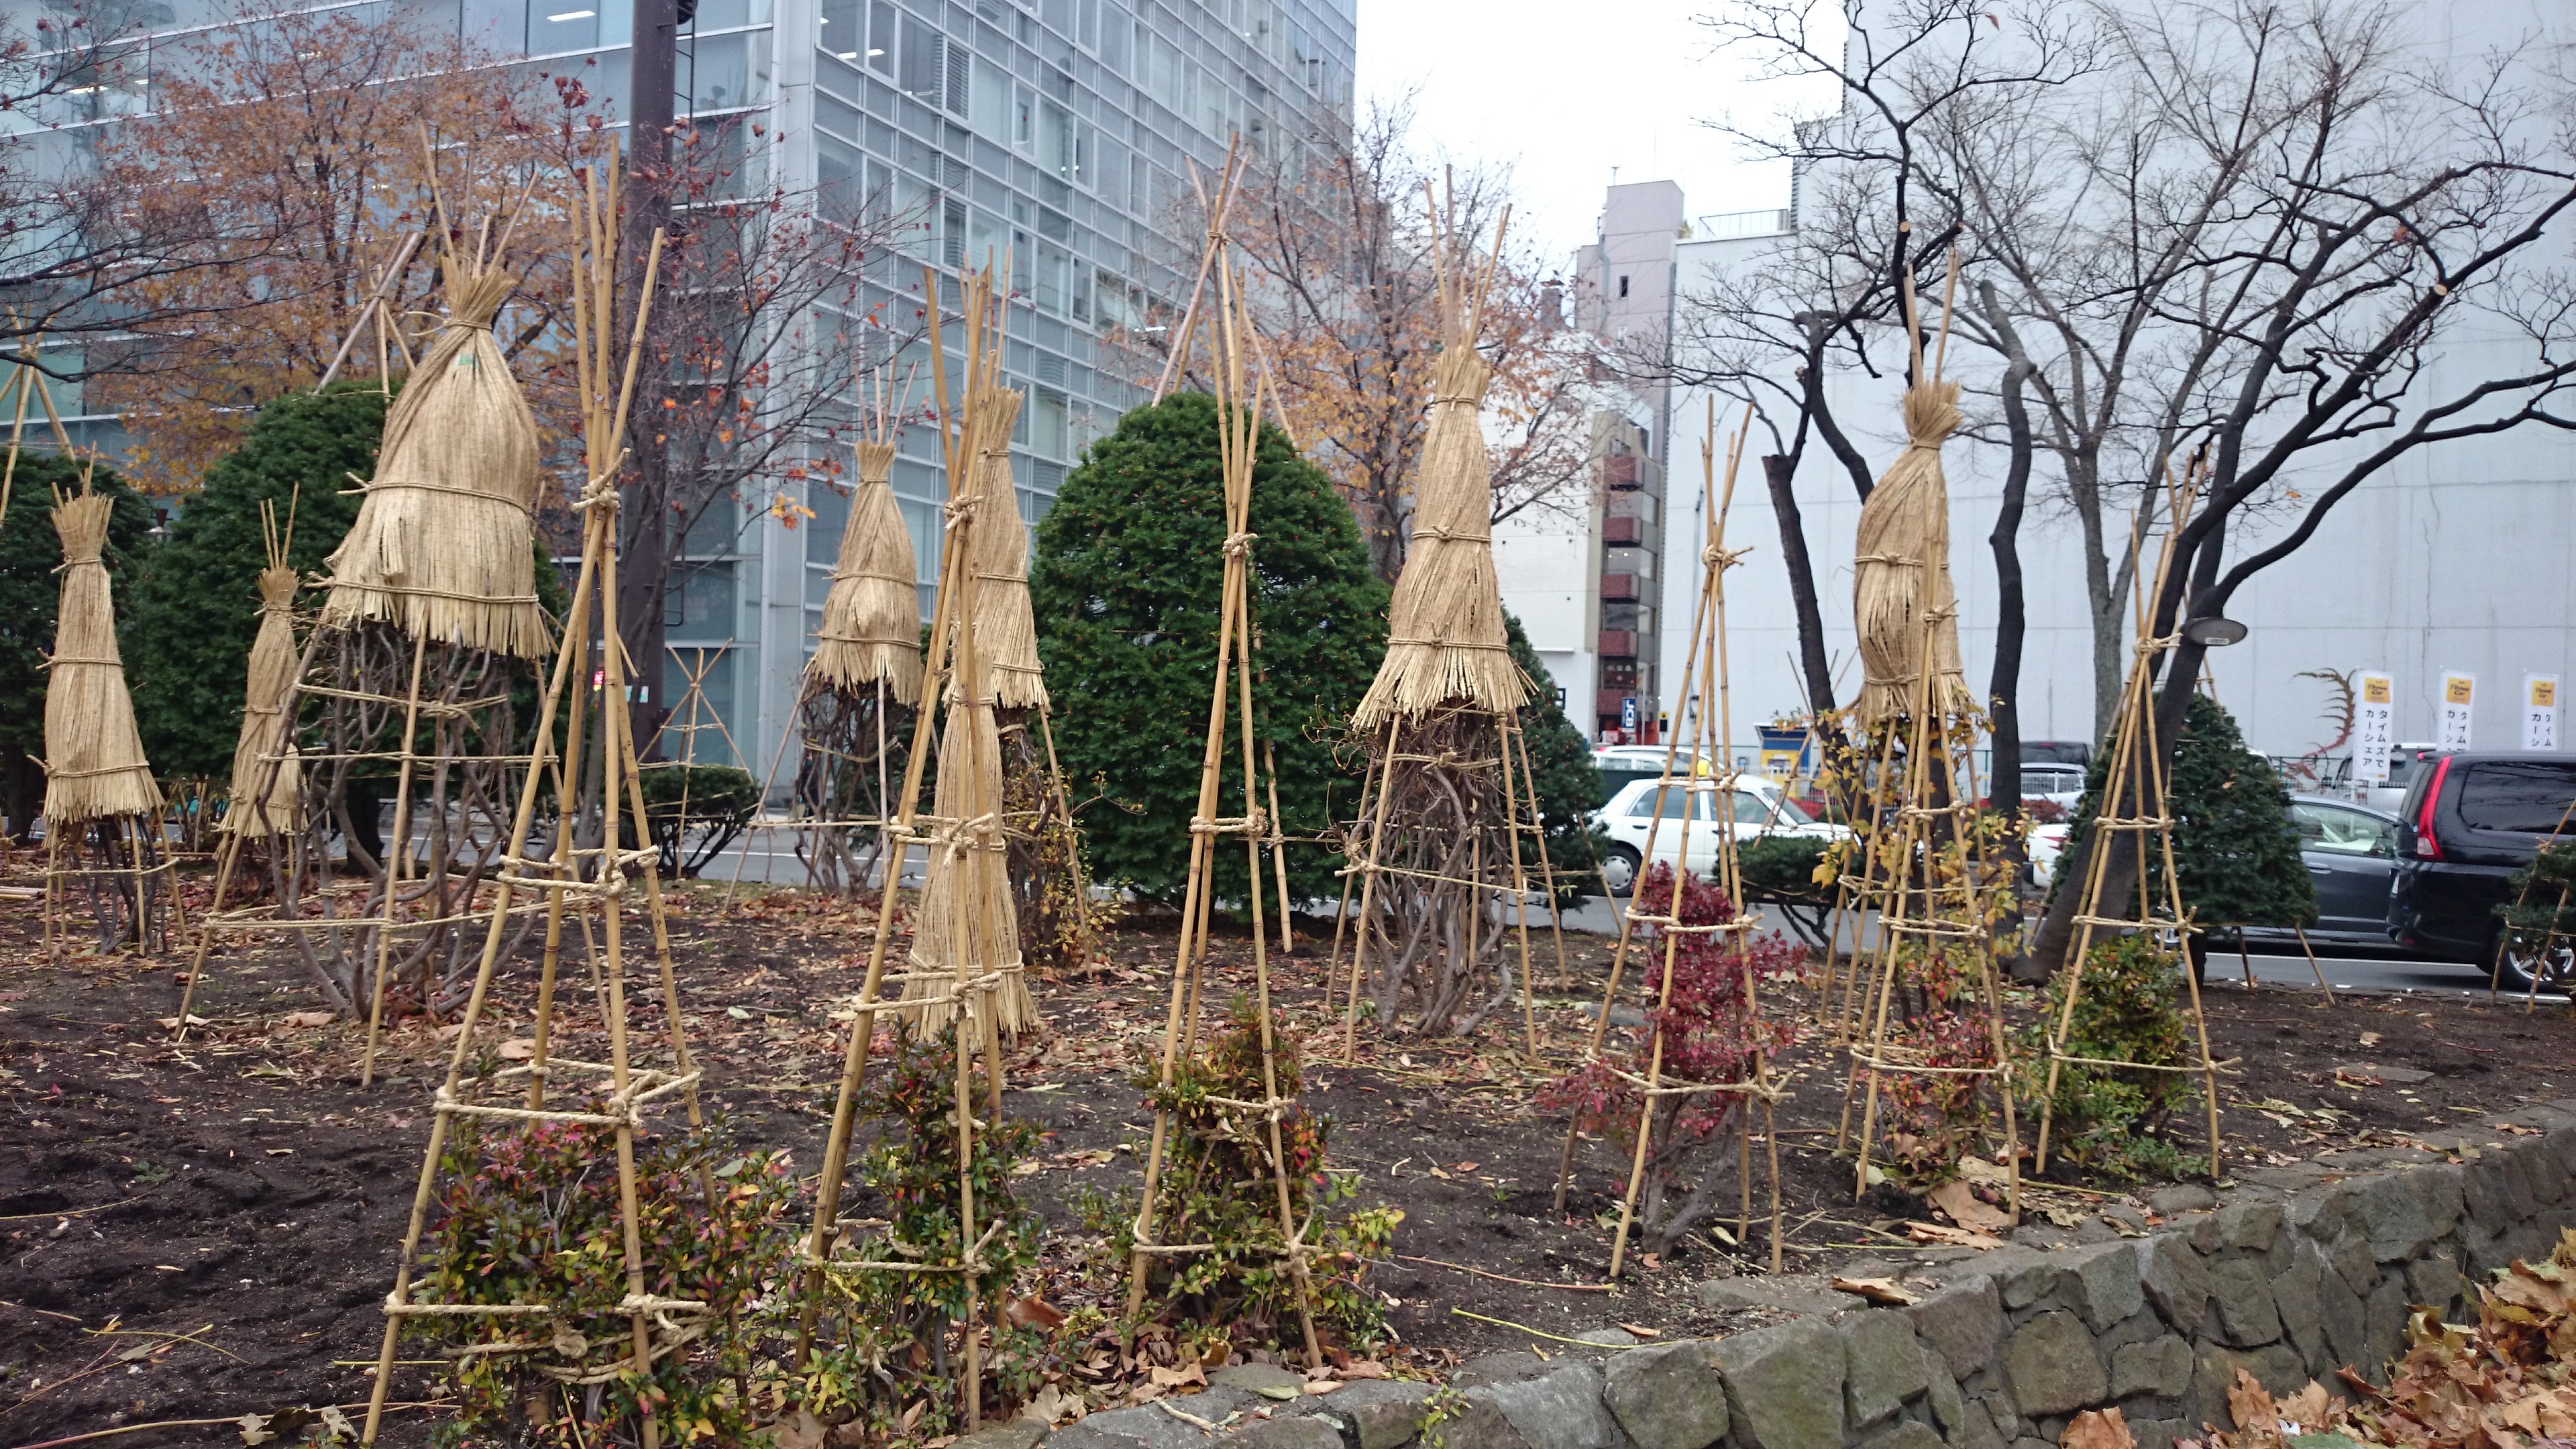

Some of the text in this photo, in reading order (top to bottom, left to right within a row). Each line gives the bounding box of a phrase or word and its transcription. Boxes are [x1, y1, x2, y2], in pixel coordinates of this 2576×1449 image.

[1625, 699, 1635, 727] JCB
[2447, 709, 2455, 751] カーシ
[2457, 711, 2467, 751] タイム
[2363, 709, 2374, 766] カーシェア
[2375, 710, 2387, 767] タイムズで
